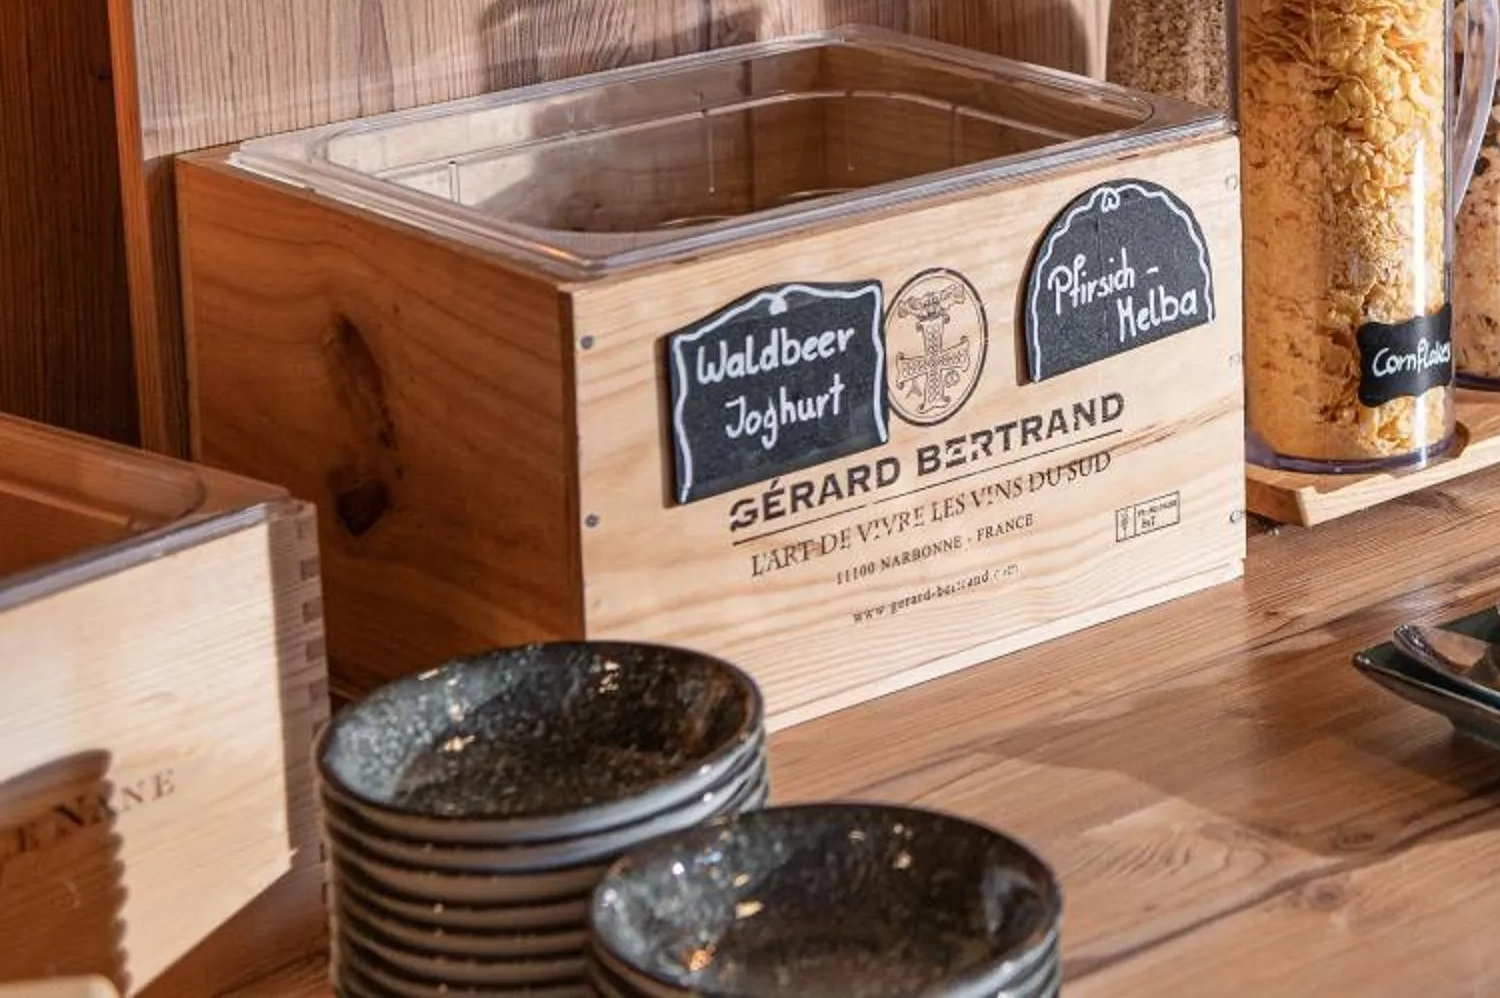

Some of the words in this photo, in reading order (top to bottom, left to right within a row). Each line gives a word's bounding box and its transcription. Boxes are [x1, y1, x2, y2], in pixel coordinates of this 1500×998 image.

[1117, 285, 1197, 343] Melba
[697, 327, 855, 384] Waldbeer
[725, 373, 846, 450] Joghurt
[729, 456, 901, 533] GÉRARD
[917, 392, 1125, 477] BERTRAND
[819, 528, 851, 557] DE
[856, 505, 925, 543] VIVRE
[930, 491, 966, 523] LES
[972, 476, 1024, 508] VINS
[1029, 464, 1062, 493] DU
[1065, 450, 1112, 482] SUD
[836, 561, 875, 585] 11100
[881, 535, 962, 571] NARBONNE
[977, 513, 1034, 542] FRANCE
